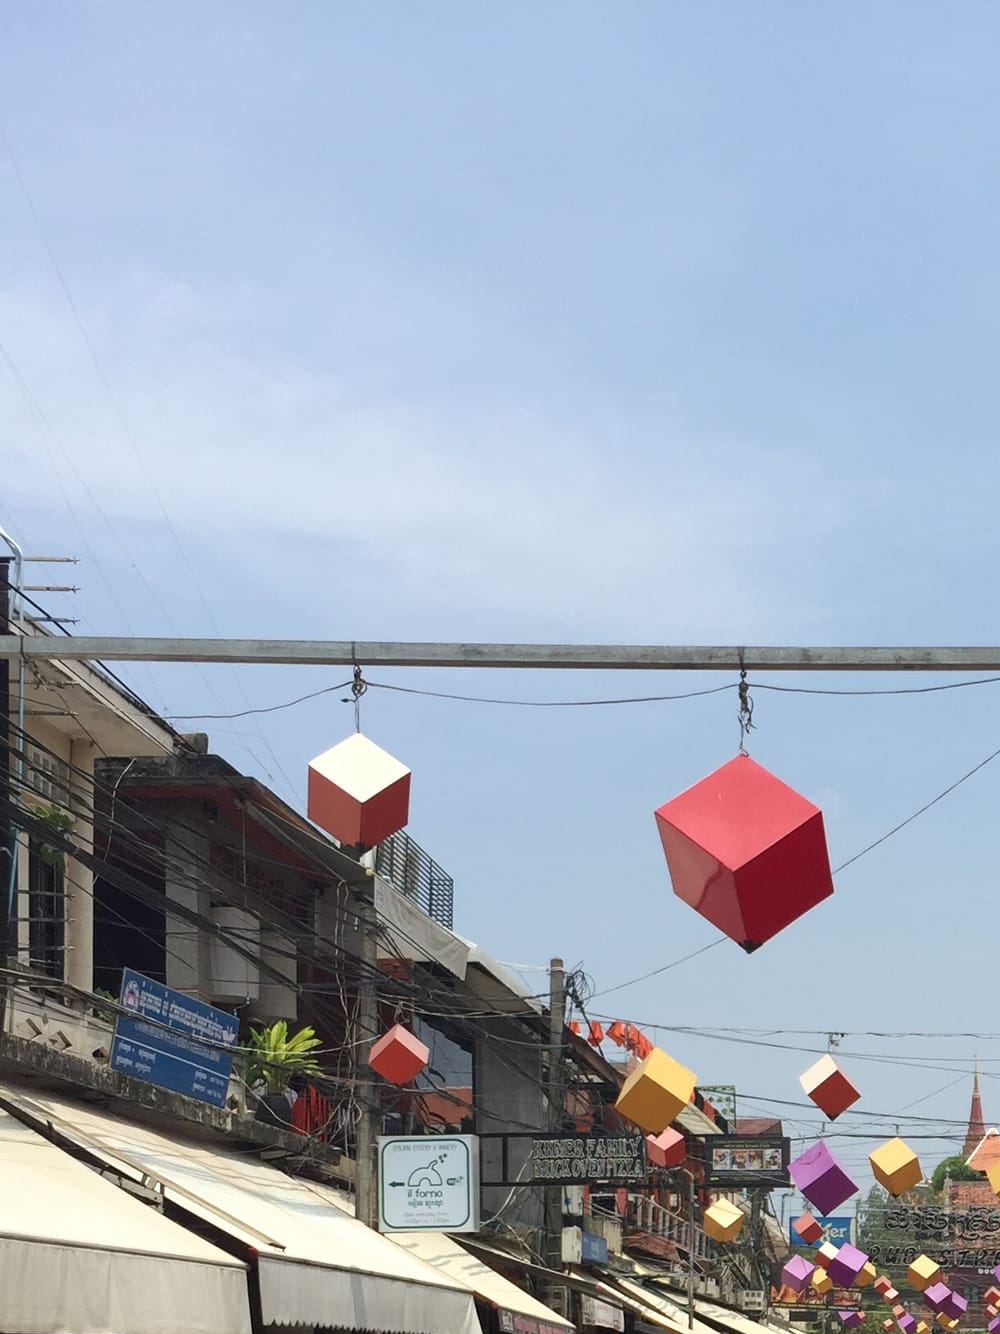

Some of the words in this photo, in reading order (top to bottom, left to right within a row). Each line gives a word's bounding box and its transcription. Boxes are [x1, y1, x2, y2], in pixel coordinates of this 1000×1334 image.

[586, 1136, 642, 1157] FAMILY
[572, 1158, 605, 1178] OVEN
[415, 1188, 443, 1198] forno
